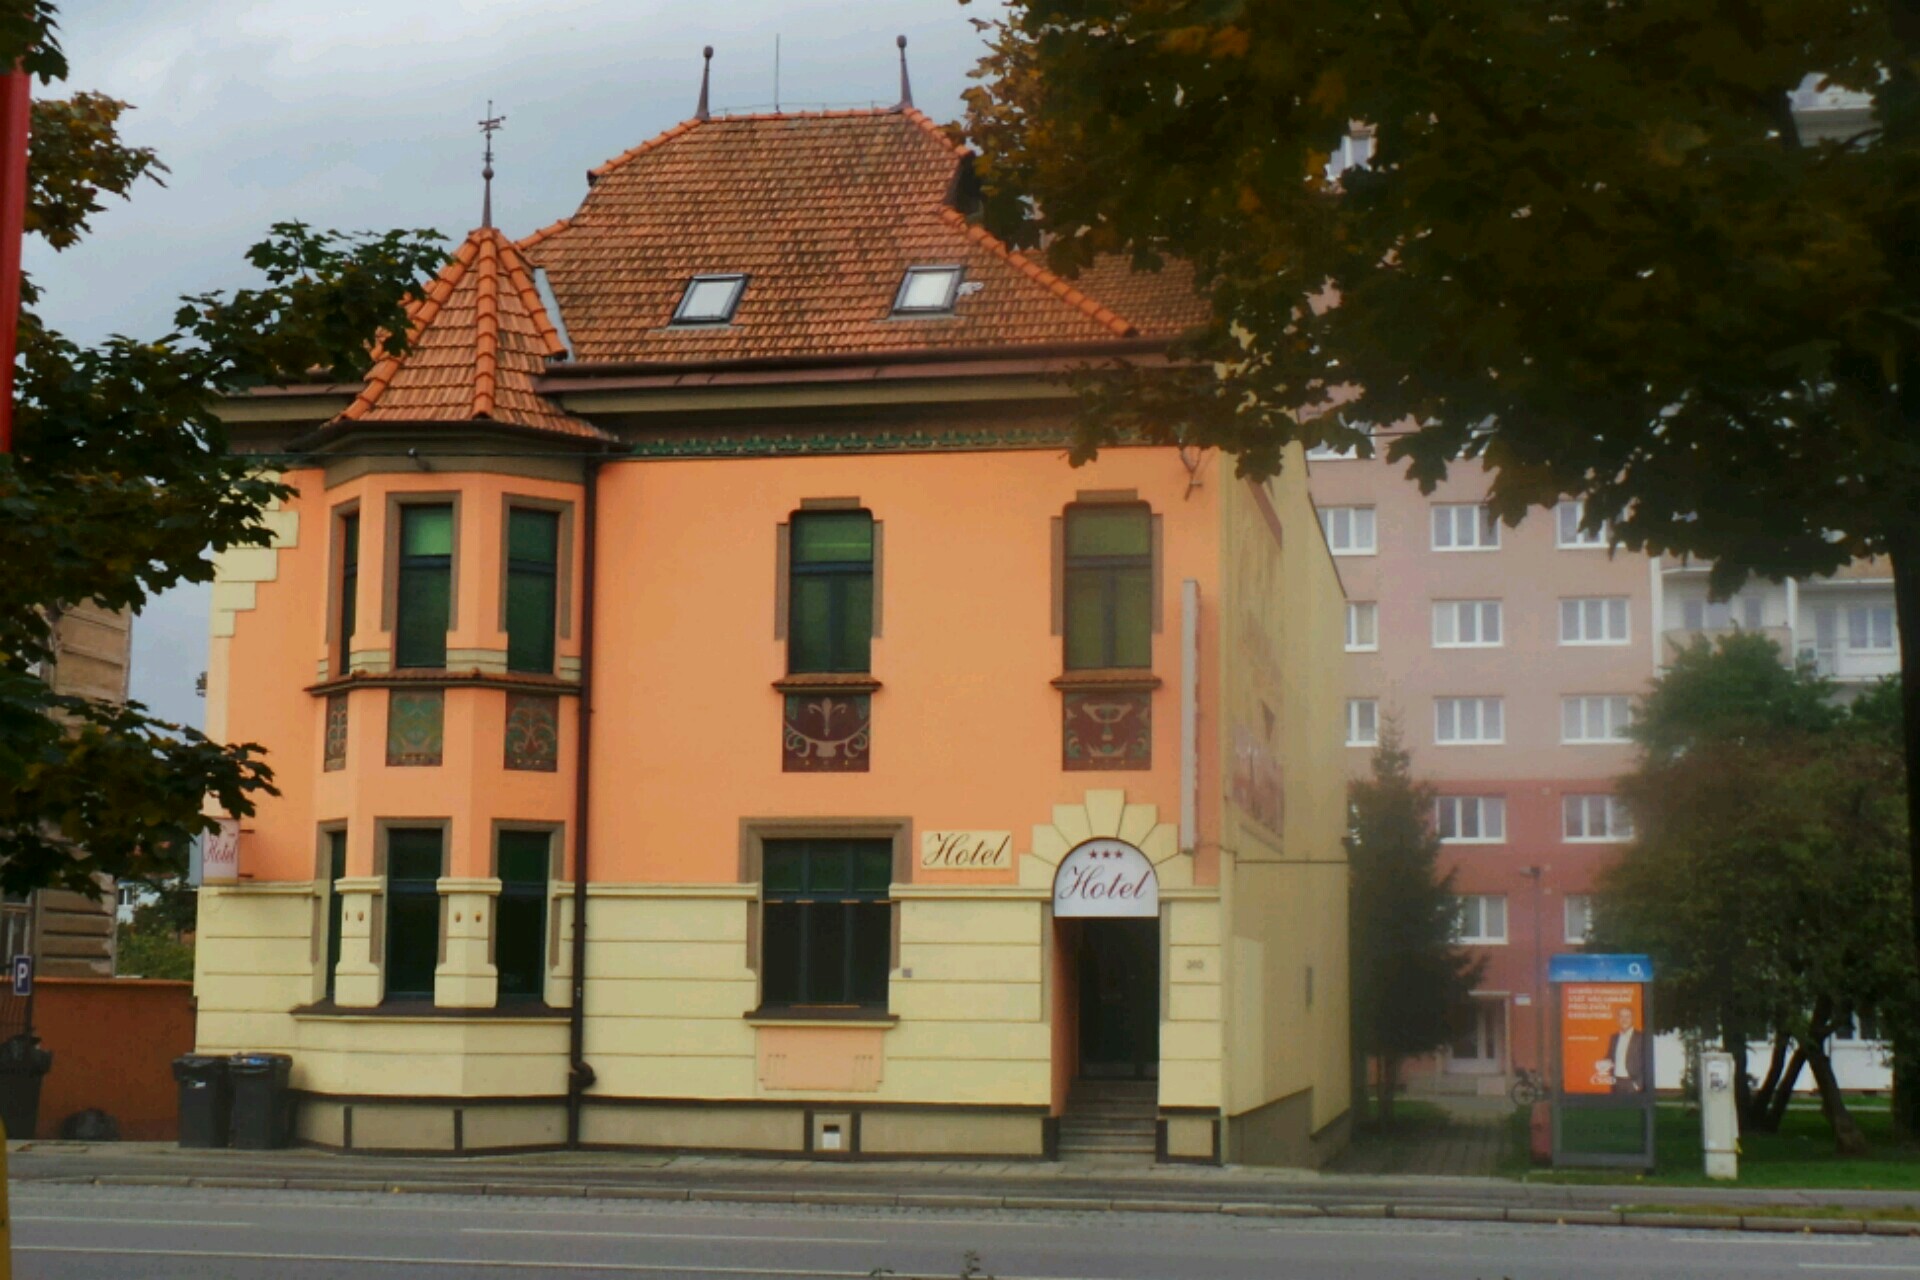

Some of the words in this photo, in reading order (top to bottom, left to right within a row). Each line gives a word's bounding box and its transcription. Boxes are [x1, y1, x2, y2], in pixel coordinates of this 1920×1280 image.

[922, 832, 1011, 867] Hotel
[1058, 864, 1150, 900] Hotel
[17, 963, 29, 988] P
